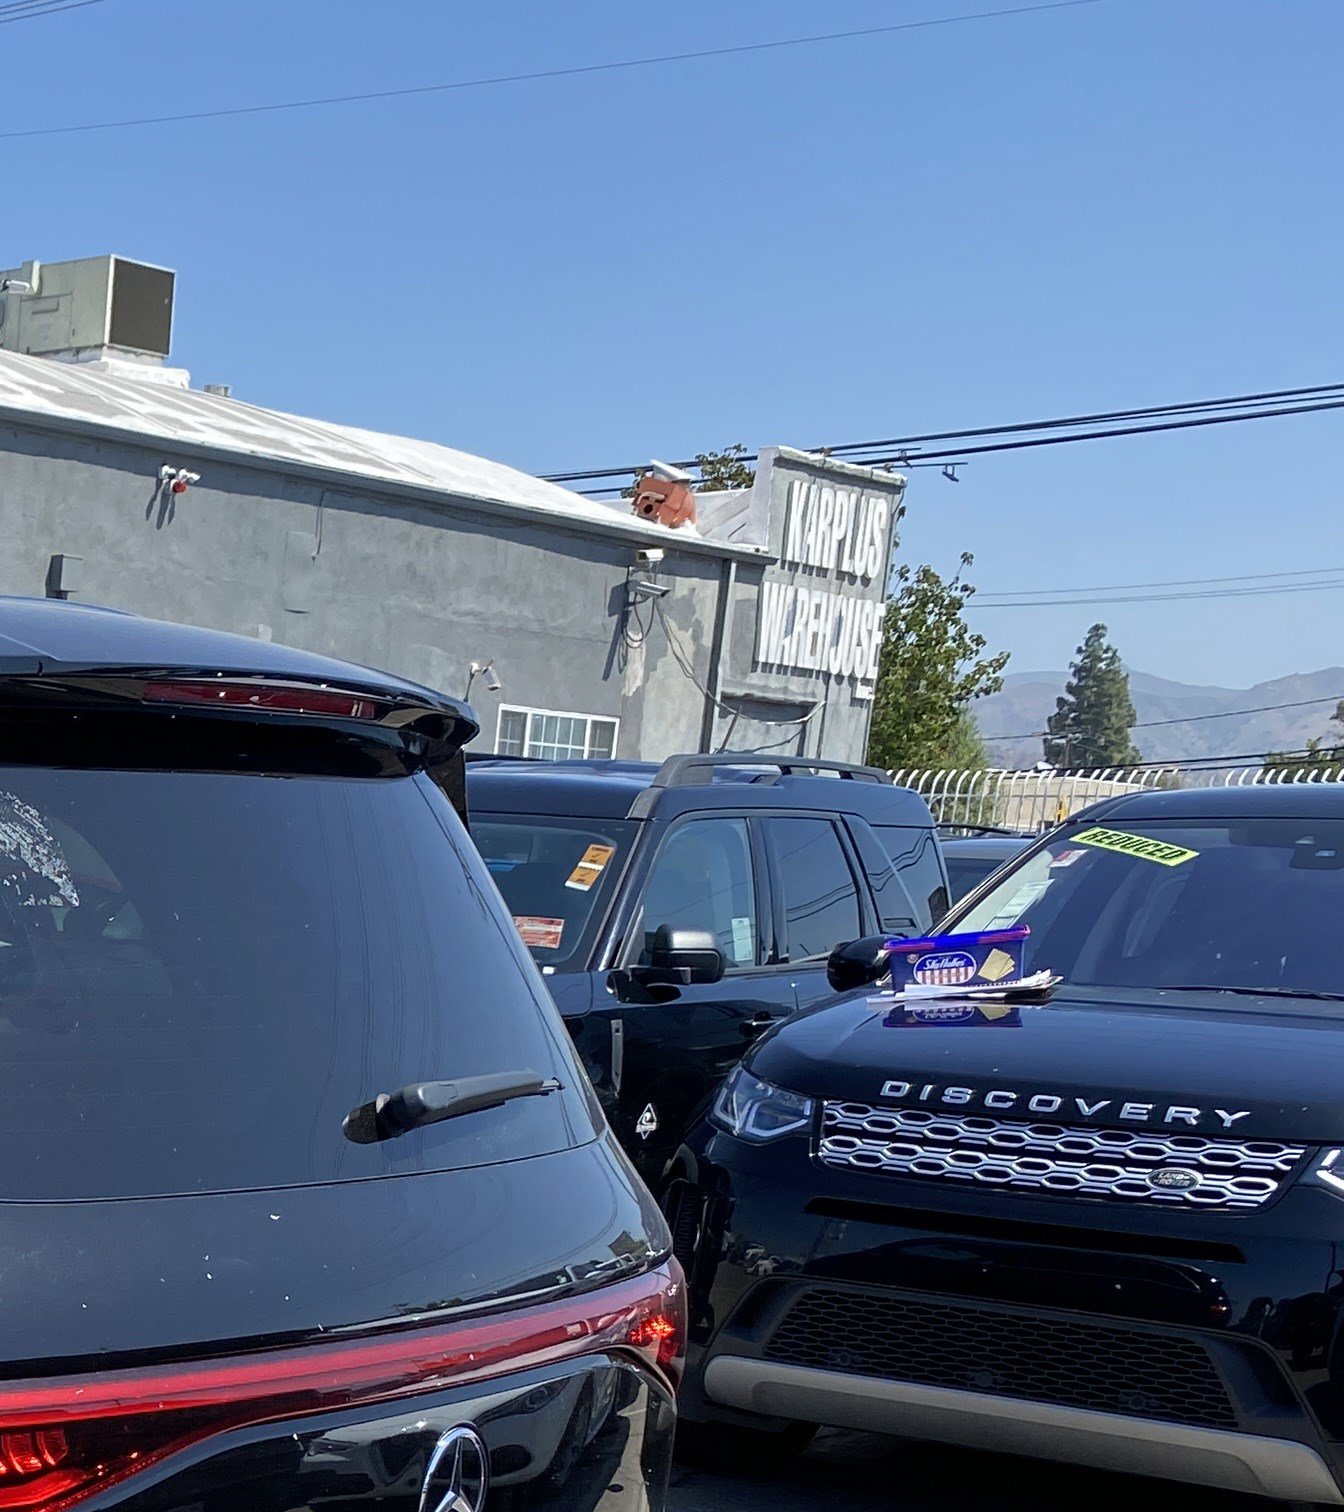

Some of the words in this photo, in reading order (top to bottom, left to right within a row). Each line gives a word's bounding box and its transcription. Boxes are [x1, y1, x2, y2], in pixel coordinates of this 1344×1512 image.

[786, 480, 888, 579] KARPLUS
[758, 581, 887, 679] WAREHOUSE
[1081, 829, 1188, 860] REDUCED
[880, 1080, 1251, 1128] DISCOVERY
